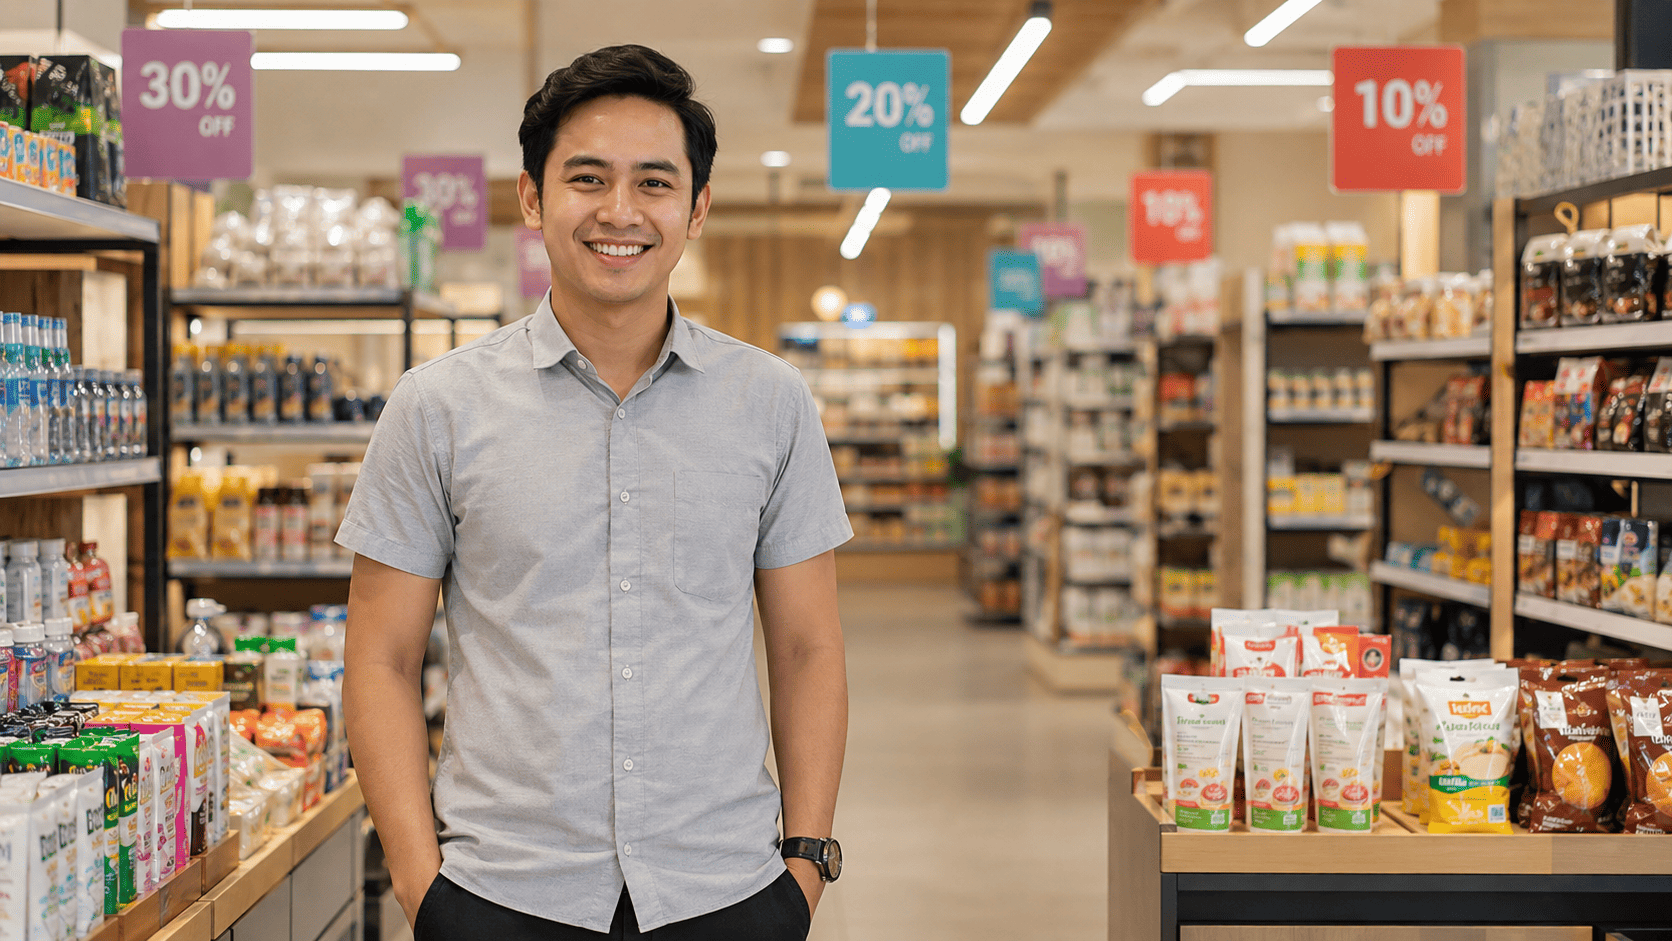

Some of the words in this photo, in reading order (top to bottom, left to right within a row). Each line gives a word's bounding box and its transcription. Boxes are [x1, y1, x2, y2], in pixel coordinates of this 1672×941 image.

[139, 60, 236, 110] 30%
[845, 81, 935, 128] 20%
[1354, 78, 1448, 129] 10%
[199, 115, 236, 137] OFF
[899, 132, 934, 154] OFF
[1411, 133, 1448, 156] OFF
